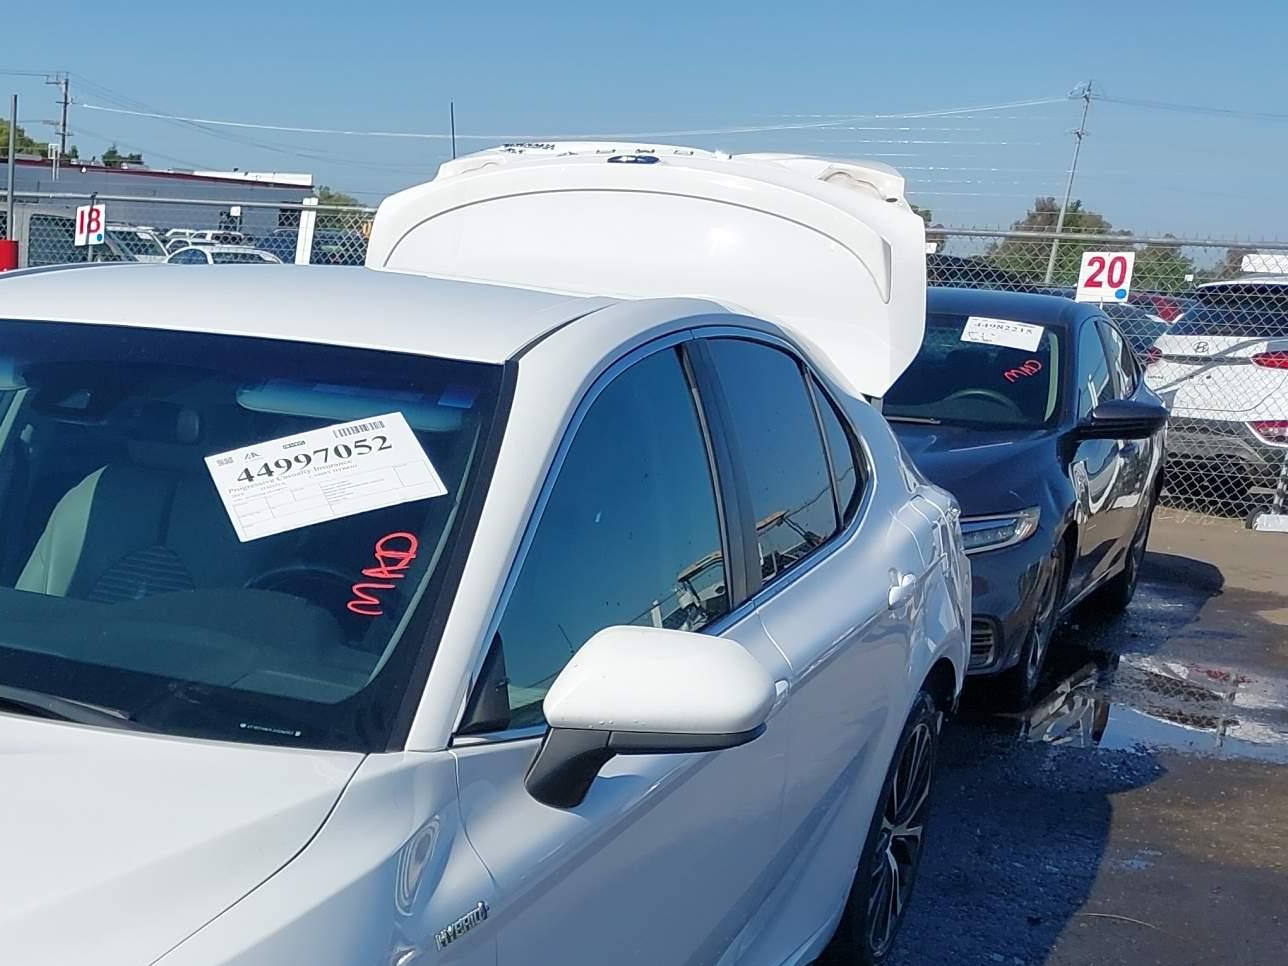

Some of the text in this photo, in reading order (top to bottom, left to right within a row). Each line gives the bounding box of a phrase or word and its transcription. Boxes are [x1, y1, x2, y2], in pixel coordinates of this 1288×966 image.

[79, 208, 101, 234] 18
[1083, 255, 1128, 289] 20
[237, 435, 392, 483] 44997052
[434, 901, 489, 952] HYBRID
